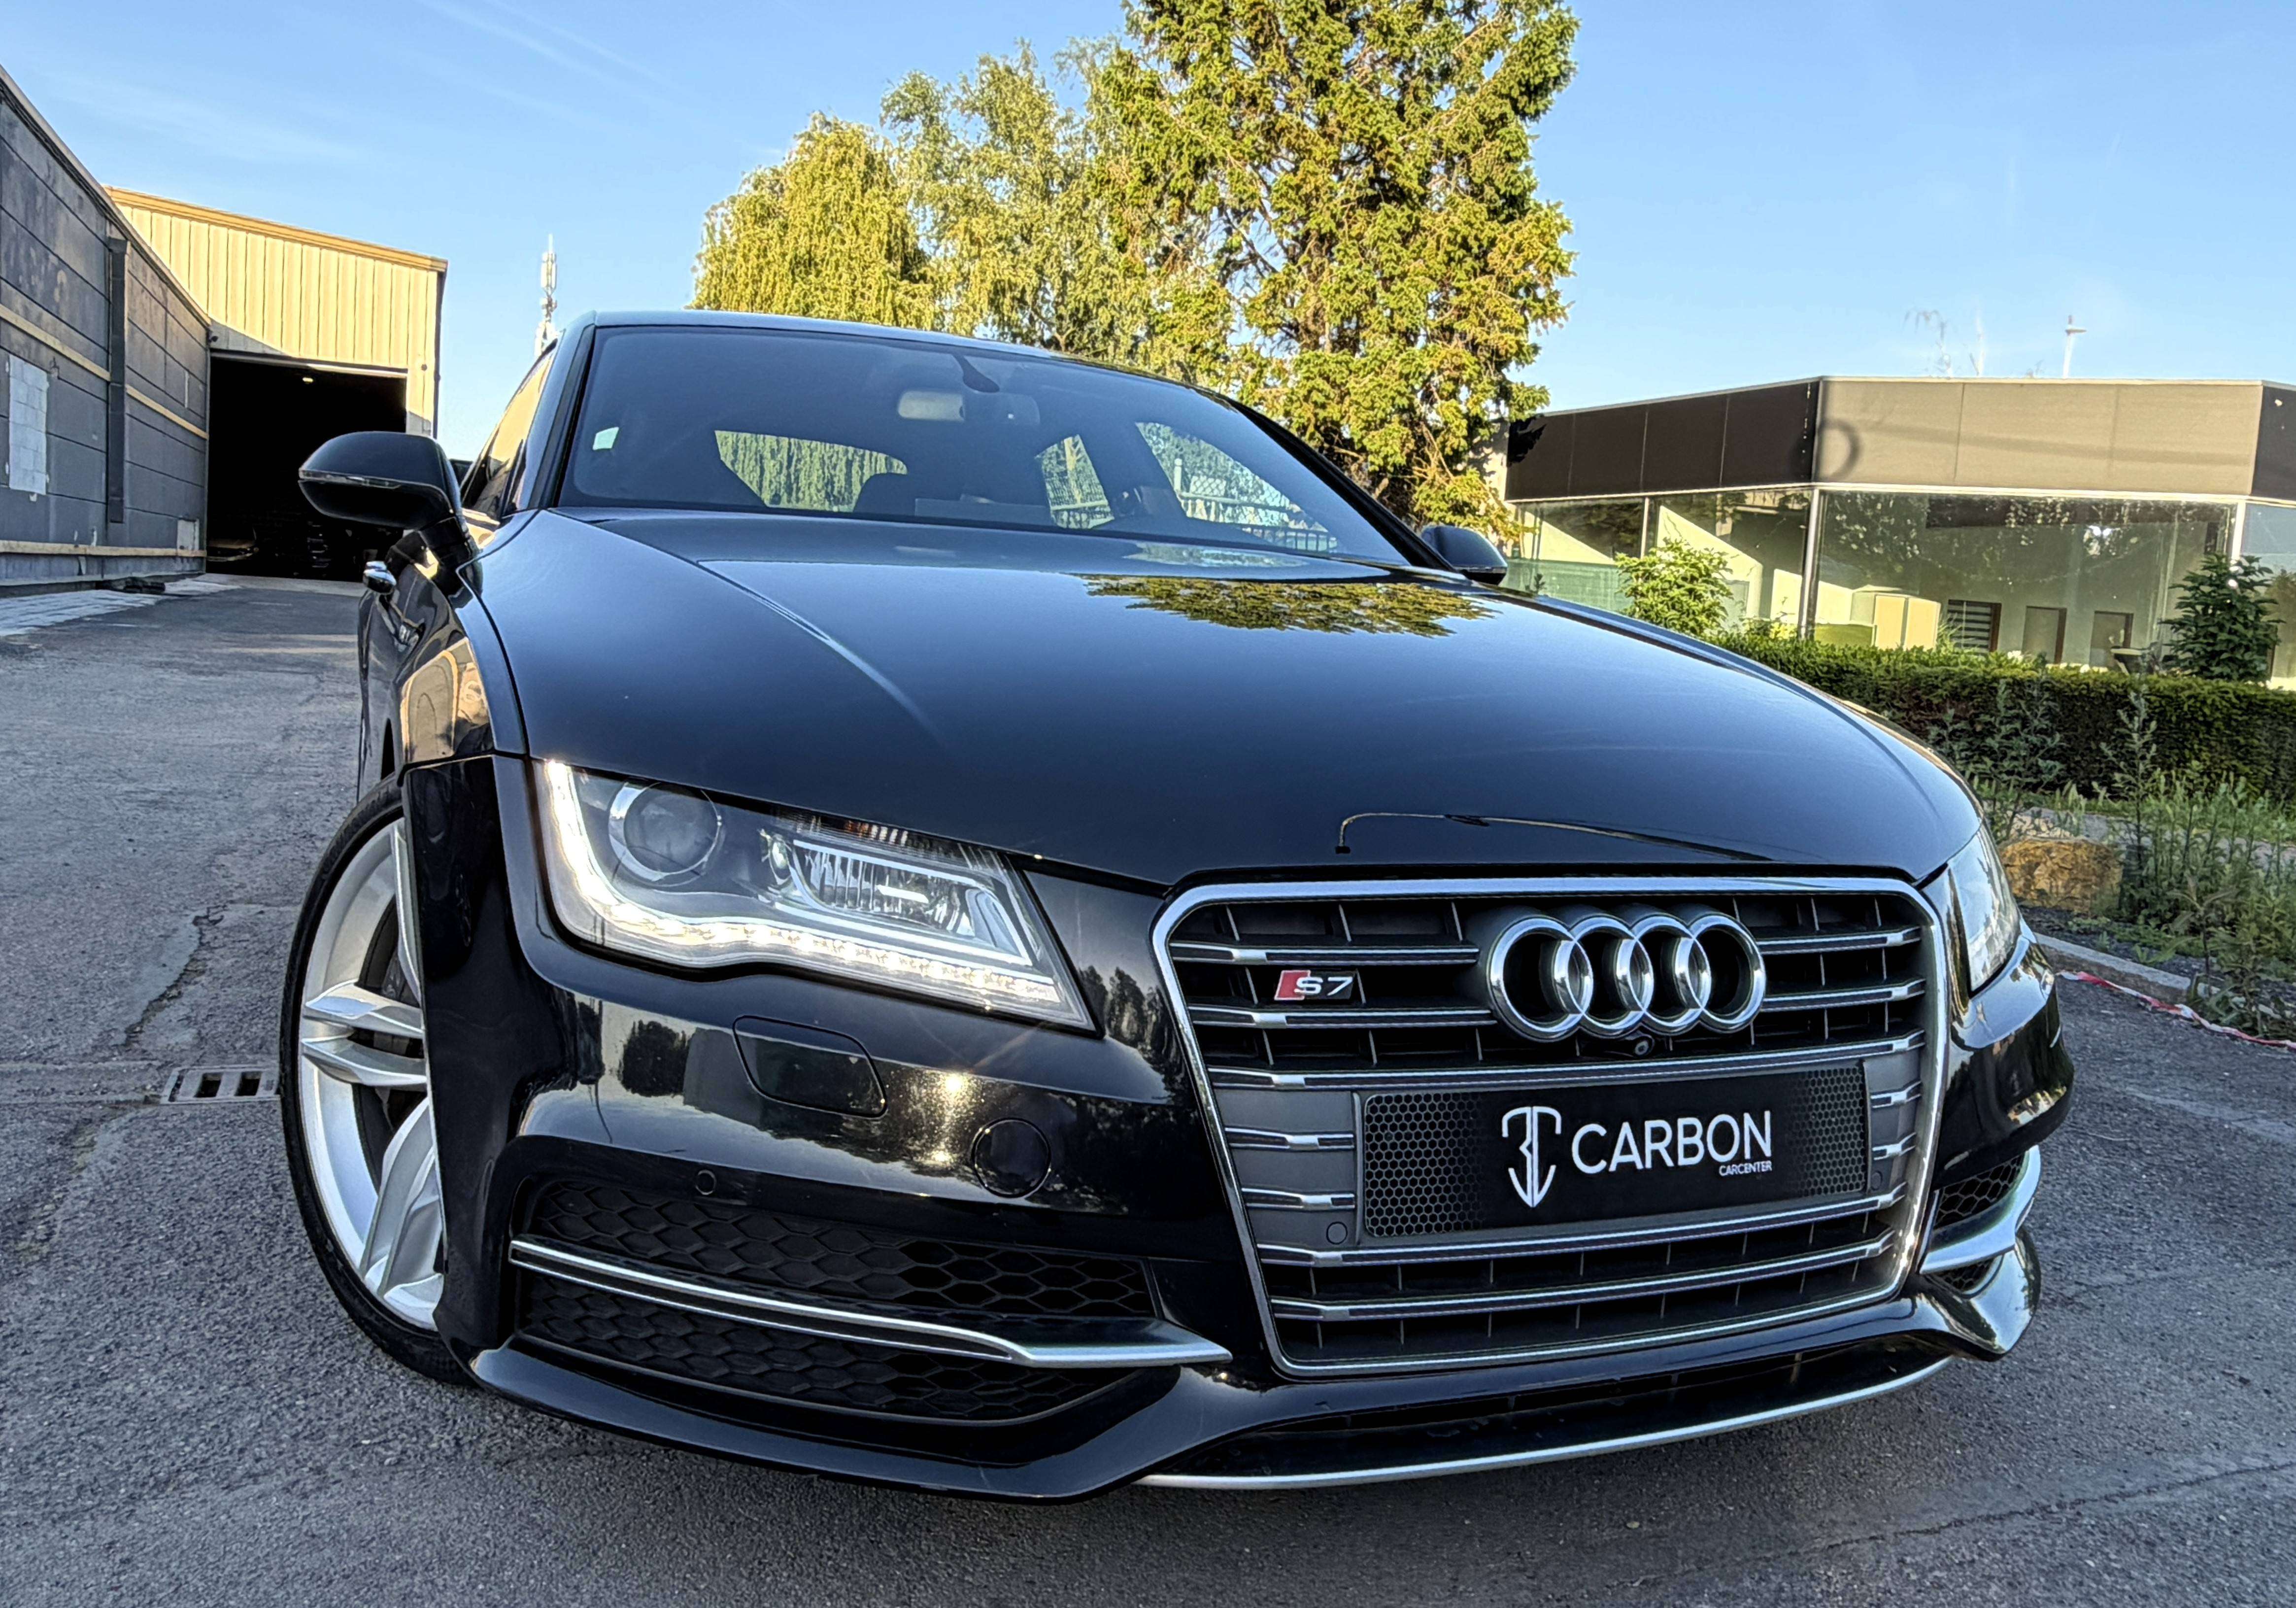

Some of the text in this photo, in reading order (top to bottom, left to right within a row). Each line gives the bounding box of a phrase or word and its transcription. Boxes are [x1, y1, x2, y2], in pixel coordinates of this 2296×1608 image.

[1294, 976, 1353, 996] S7
[1571, 1110, 1772, 1174] CARBON
[1719, 1160, 1773, 1176] CARCENTER
